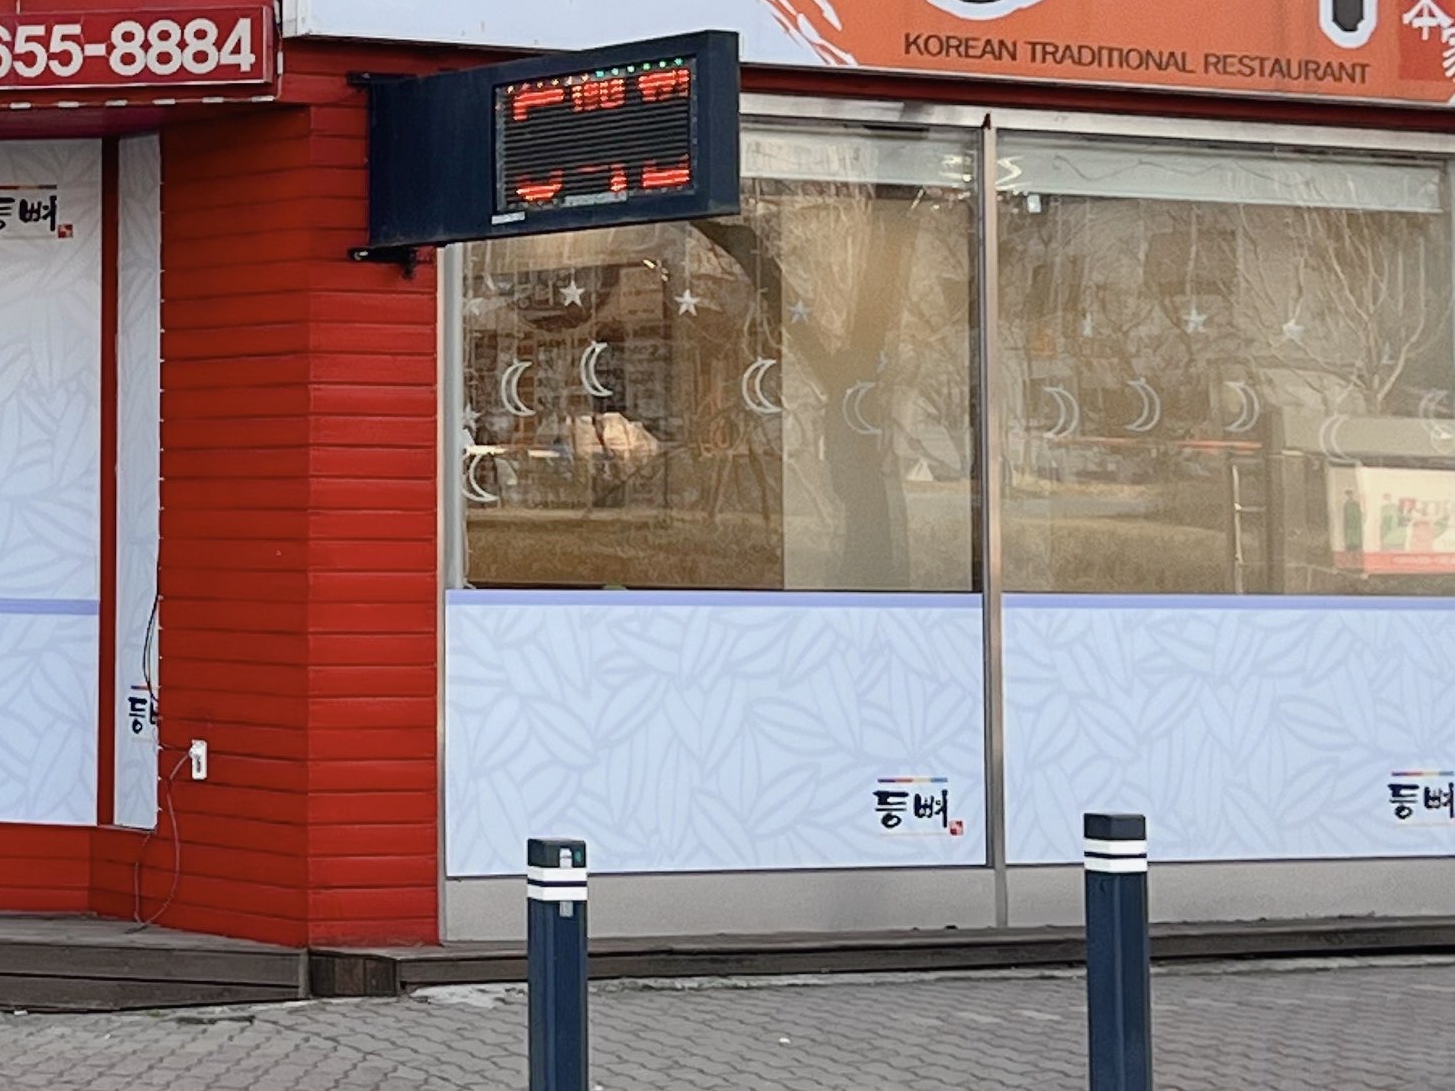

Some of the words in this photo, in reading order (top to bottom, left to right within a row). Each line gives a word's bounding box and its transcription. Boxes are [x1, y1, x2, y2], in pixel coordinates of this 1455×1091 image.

[903, 31, 1018, 62] KOREAN
[1023, 40, 1196, 74] TRADITIONAL
[1203, 52, 1371, 85] RESTAURANT
[128, 696, 158, 734] 등
[873, 790, 948, 828] 등뼈
[1387, 781, 1454, 820] 등뼈
